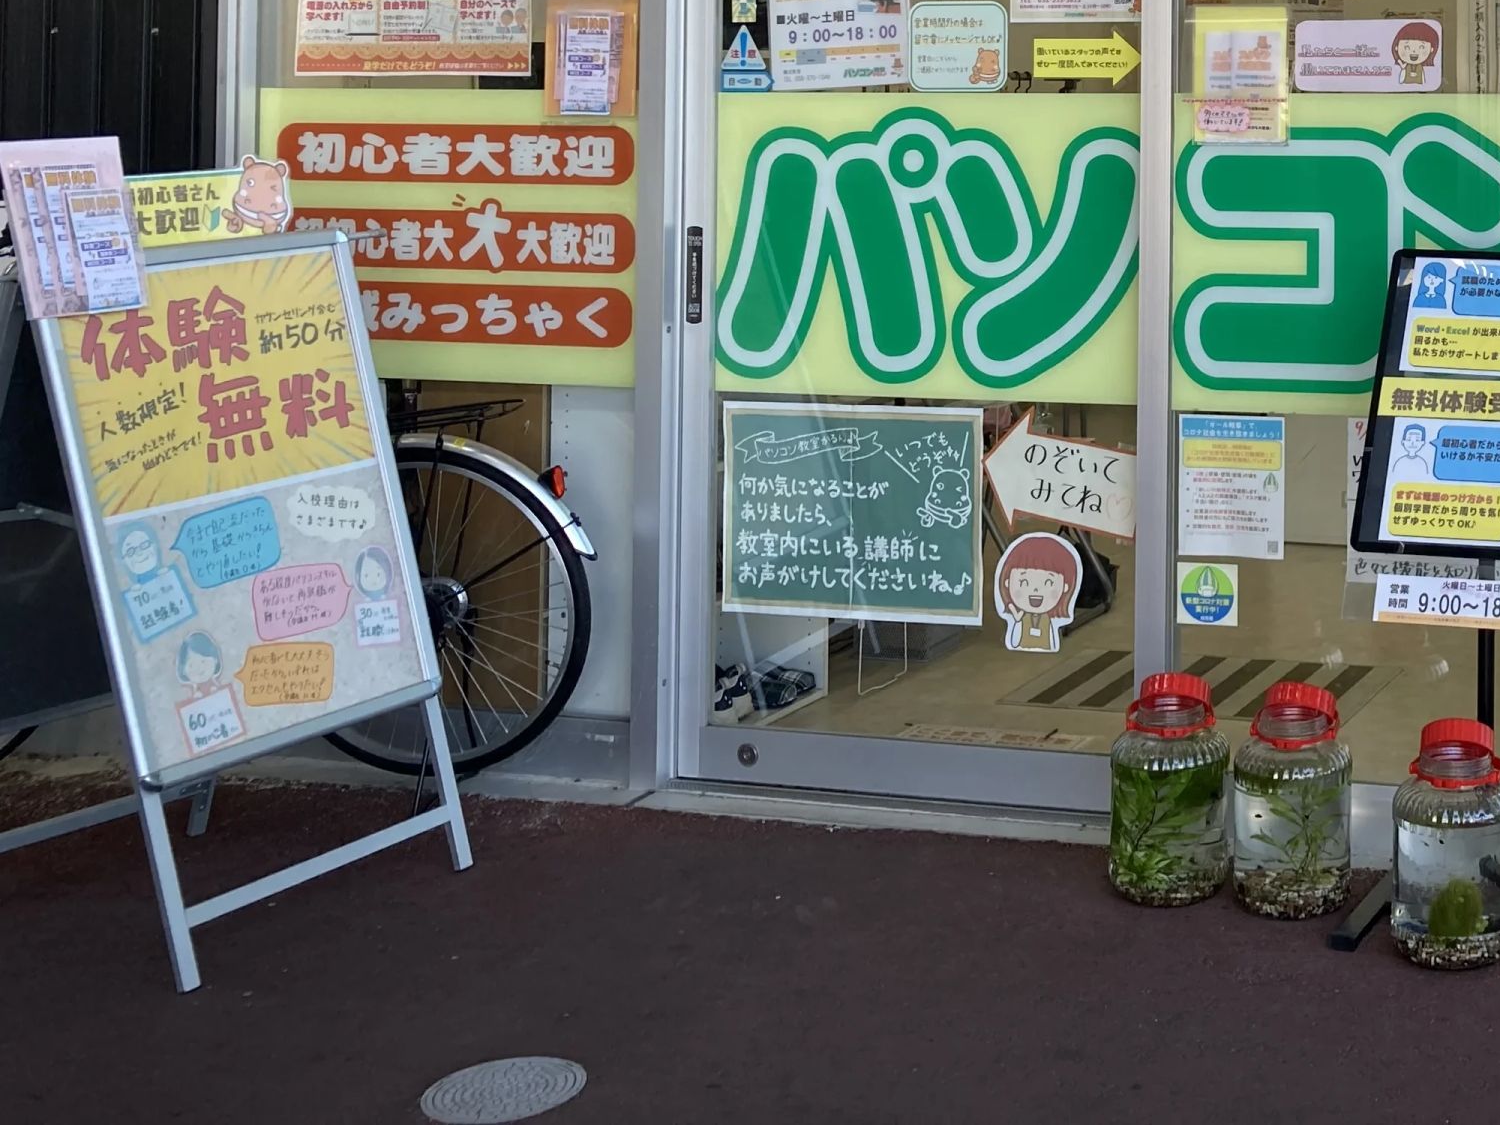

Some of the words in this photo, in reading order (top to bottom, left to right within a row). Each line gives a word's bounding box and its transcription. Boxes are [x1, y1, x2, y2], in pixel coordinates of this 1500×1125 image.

[731, 49, 757, 59] 注意
[297, 132, 615, 178] 初心者大歓迎
[80, 285, 250, 381] 体験
[258, 318, 346, 354] 約50分
[197, 368, 355, 463] 無料
[895, 431, 949, 458] いつでも
[908, 452, 946, 473] どうぞ
[1025, 443, 1122, 484] のぞいて
[738, 472, 889, 499] 何か気になることが
[1030, 478, 1103, 514] みてね
[297, 493, 360, 510] 入校理由は
[740, 503, 832, 527] ありましたら、
[736, 531, 942, 562] 教室内にいる講師に
[1389, 583, 1410, 594] 営業
[1441, 581, 1500, 593] 火曜日～土曜日
[1387, 598, 1408, 609] 時間
